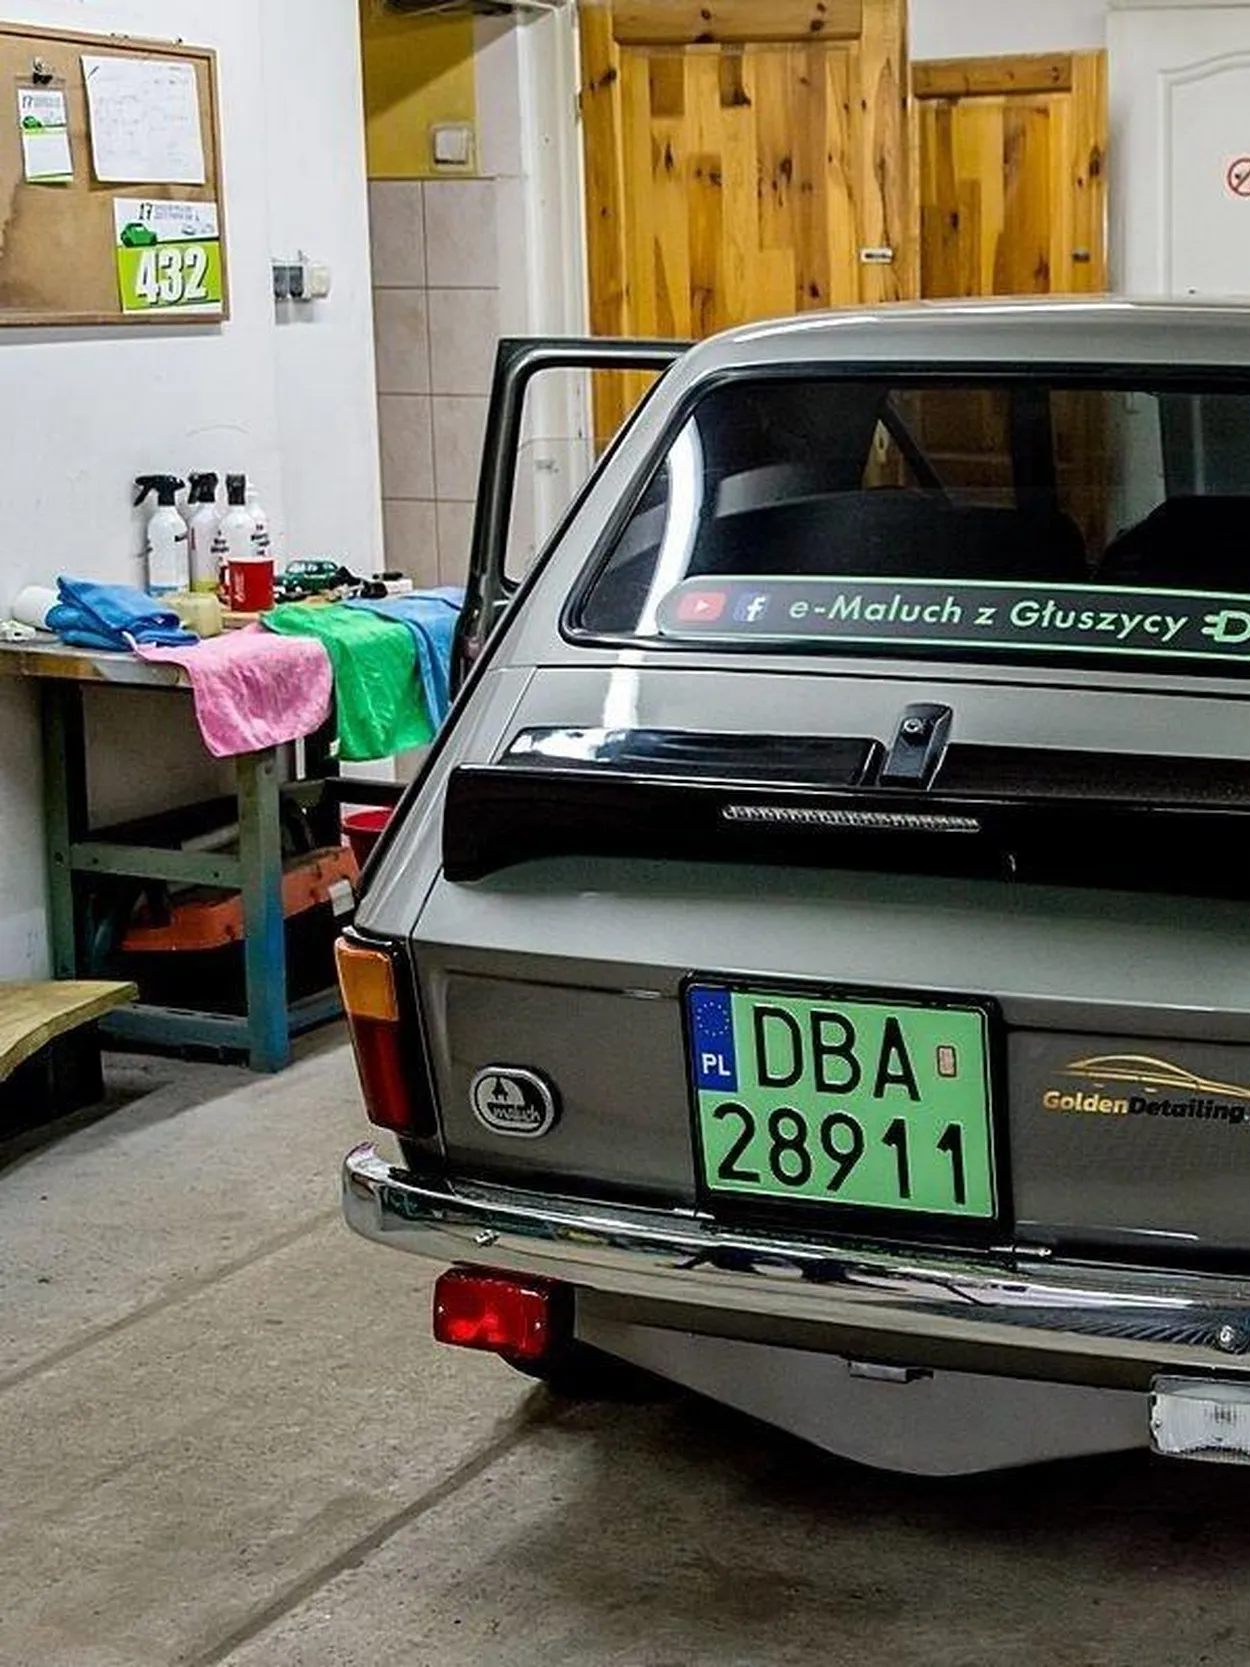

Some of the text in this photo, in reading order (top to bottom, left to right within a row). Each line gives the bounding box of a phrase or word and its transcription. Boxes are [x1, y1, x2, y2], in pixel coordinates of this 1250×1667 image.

[135, 247, 209, 305] 432
[788, 591, 1189, 642] e-Maluch z Głuszycy
[701, 1052, 732, 1077] PL
[753, 1003, 921, 1101] DBA
[712, 1102, 966, 1205] 28911
